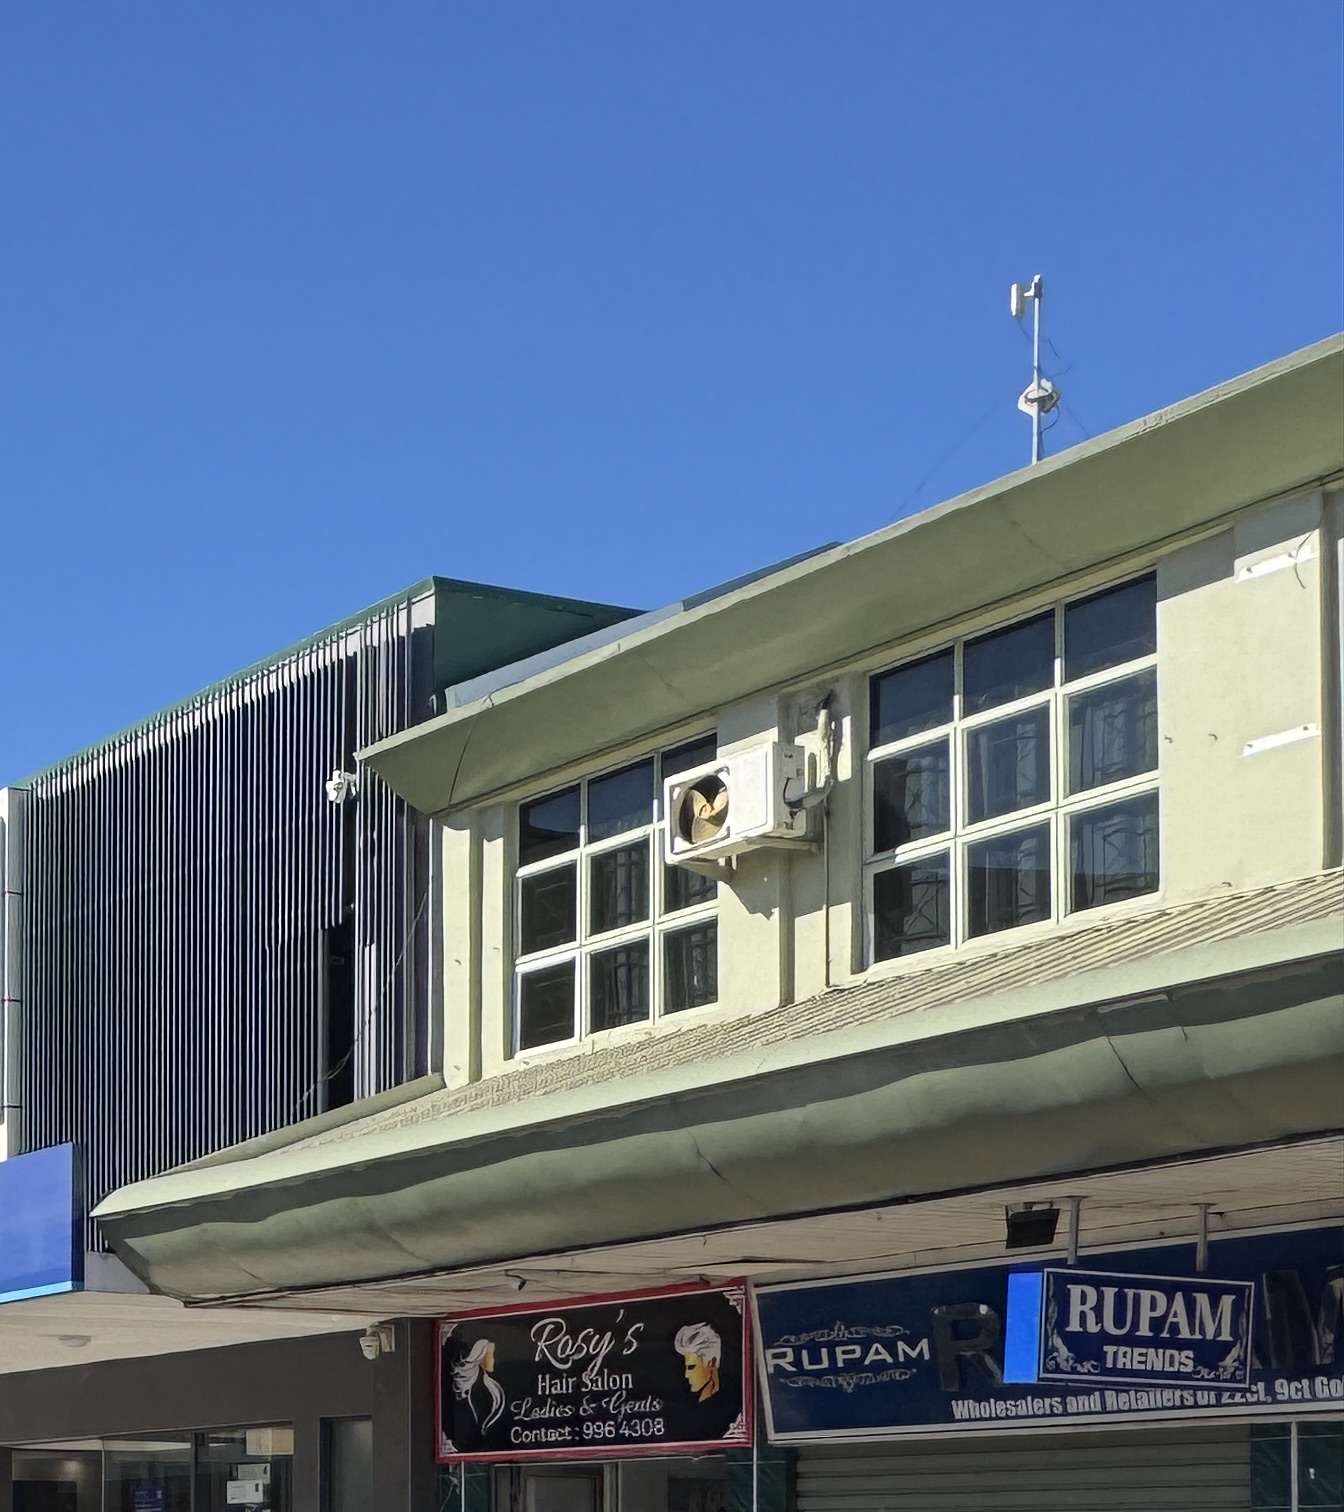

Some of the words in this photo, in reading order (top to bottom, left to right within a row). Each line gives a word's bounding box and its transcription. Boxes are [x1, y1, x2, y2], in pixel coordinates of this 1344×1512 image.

[1064, 1284, 1236, 1342] RUPAM
[530, 1308, 644, 1379] Rosy's
[765, 1338, 931, 1374] RUPAM
[1103, 1345, 1194, 1373] TRENDS
[537, 1373, 577, 1396] Hair
[580, 1370, 634, 1393] Salon
[951, 1395, 1063, 1420] Wholesalers
[1066, 1391, 1102, 1414] and
[1104, 1388, 1195, 1411] Retailers
[1274, 1378, 1312, 1401] 9ct
[1314, 1375, 1344, 1399] Go
[510, 1398, 575, 1421] Ladies
[579, 1397, 597, 1418] &
[601, 1391, 663, 1426] Gents
[583, 1421, 616, 1440] 996
[619, 1418, 665, 1438] 4308
